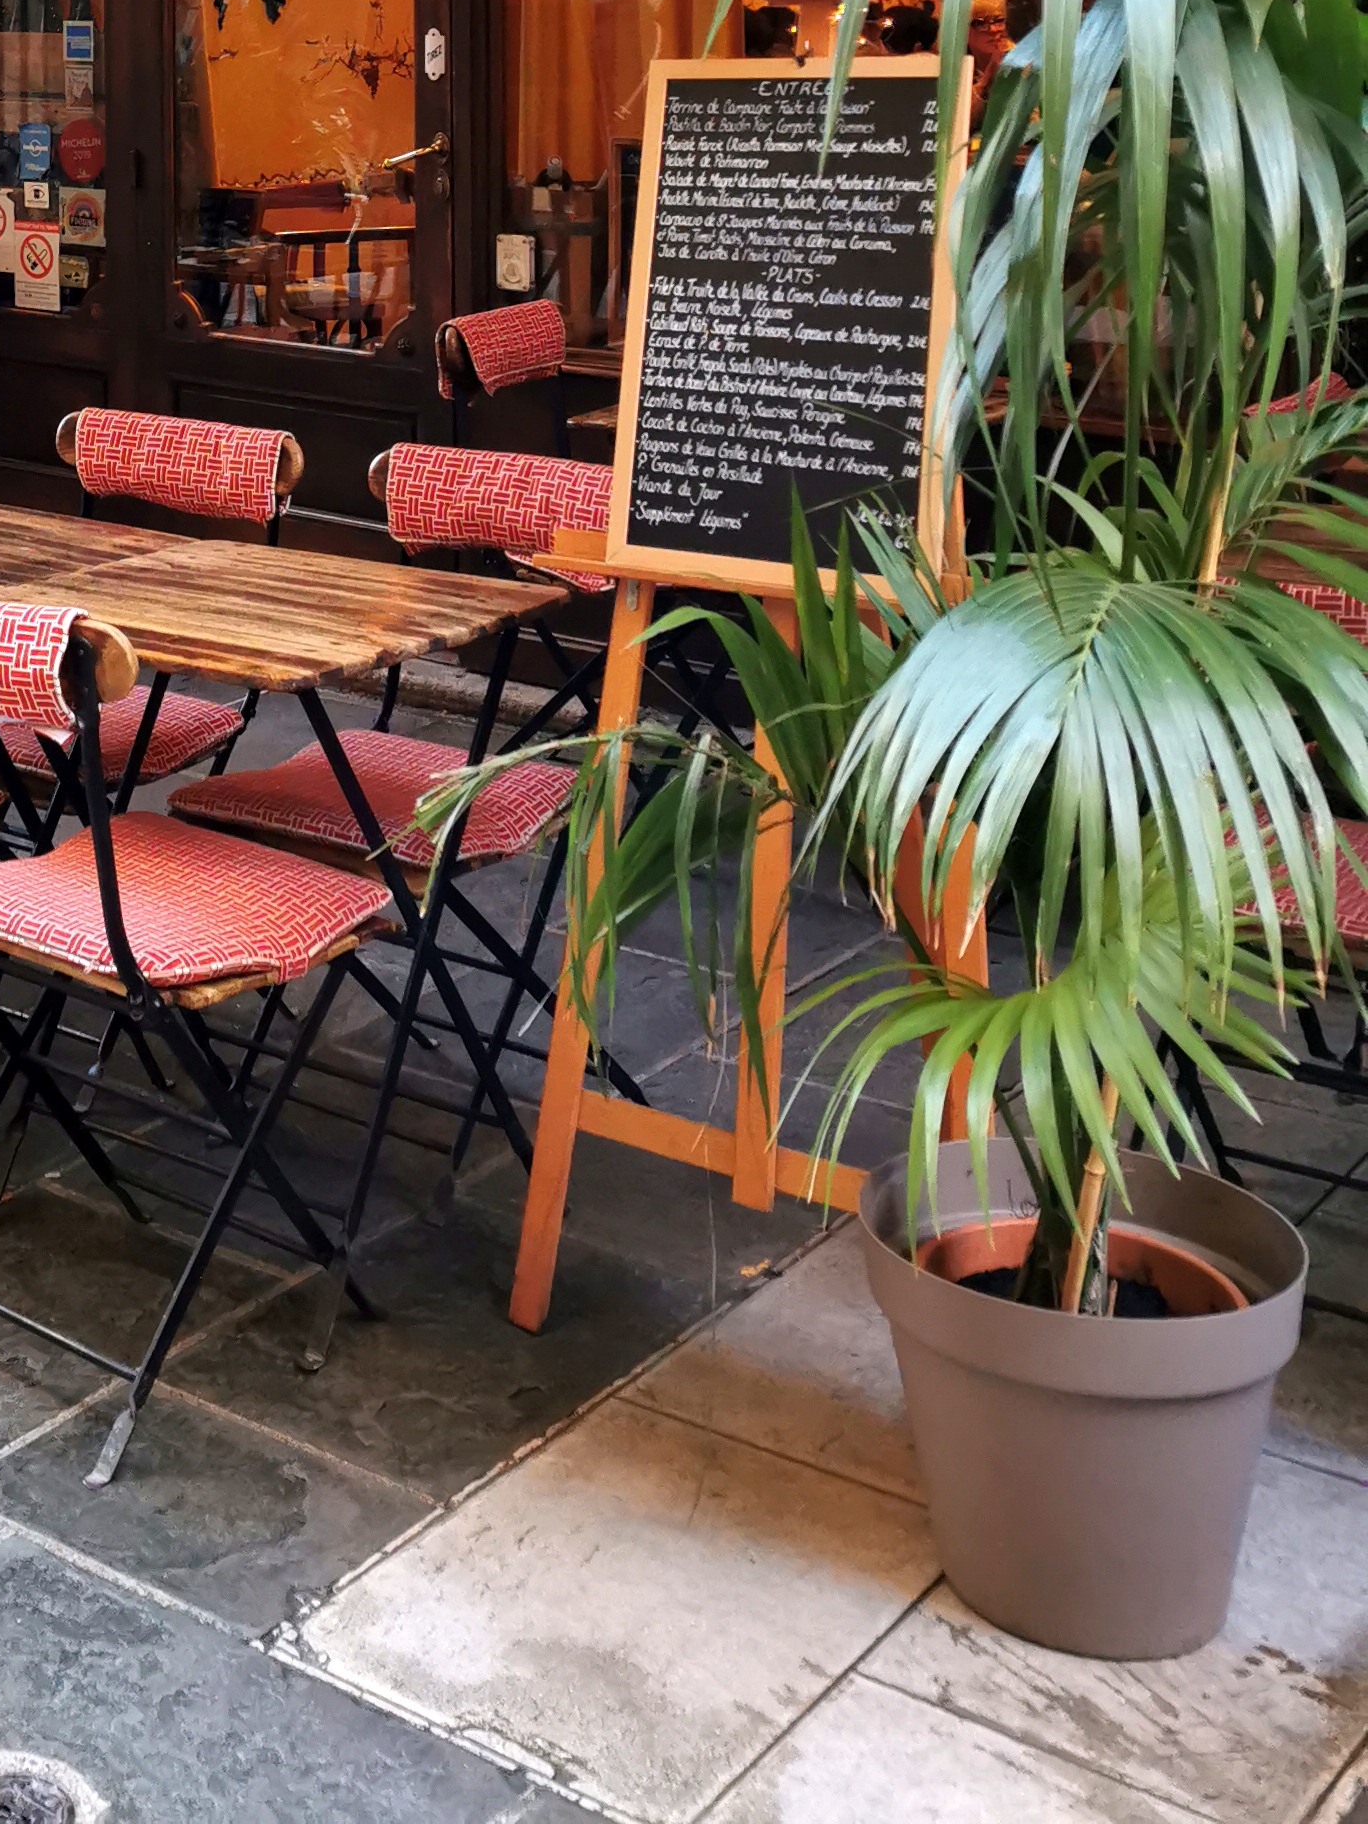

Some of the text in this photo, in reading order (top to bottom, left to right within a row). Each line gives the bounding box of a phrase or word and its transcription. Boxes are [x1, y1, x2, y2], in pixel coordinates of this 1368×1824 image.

[706, 97, 720, 114] de
[722, 98, 773, 118] Campagne
[704, 116, 717, 132] de
[60, 137, 102, 149] MICHELIN
[699, 153, 712, 168] de
[695, 171, 708, 187] de
[737, 172, 749, 188] de
[704, 211, 715, 227] de
[853, 216, 866, 232] de
[793, 233, 805, 248] de
[658, 243, 676, 258] Jus
[678, 244, 691, 259] de
[673, 277, 686, 297] de
[717, 280, 729, 299] de
[849, 288, 864, 307] de
[740, 321, 752, 336] de
[834, 327, 849, 343] de
[683, 334, 697, 350] de
[708, 337, 721, 351] de
[673, 372, 685, 388] de
[676, 416, 689, 433] de
[681, 438, 694, 456] de
[678, 479, 692, 497] du
[689, 482, 724, 506] Jour
